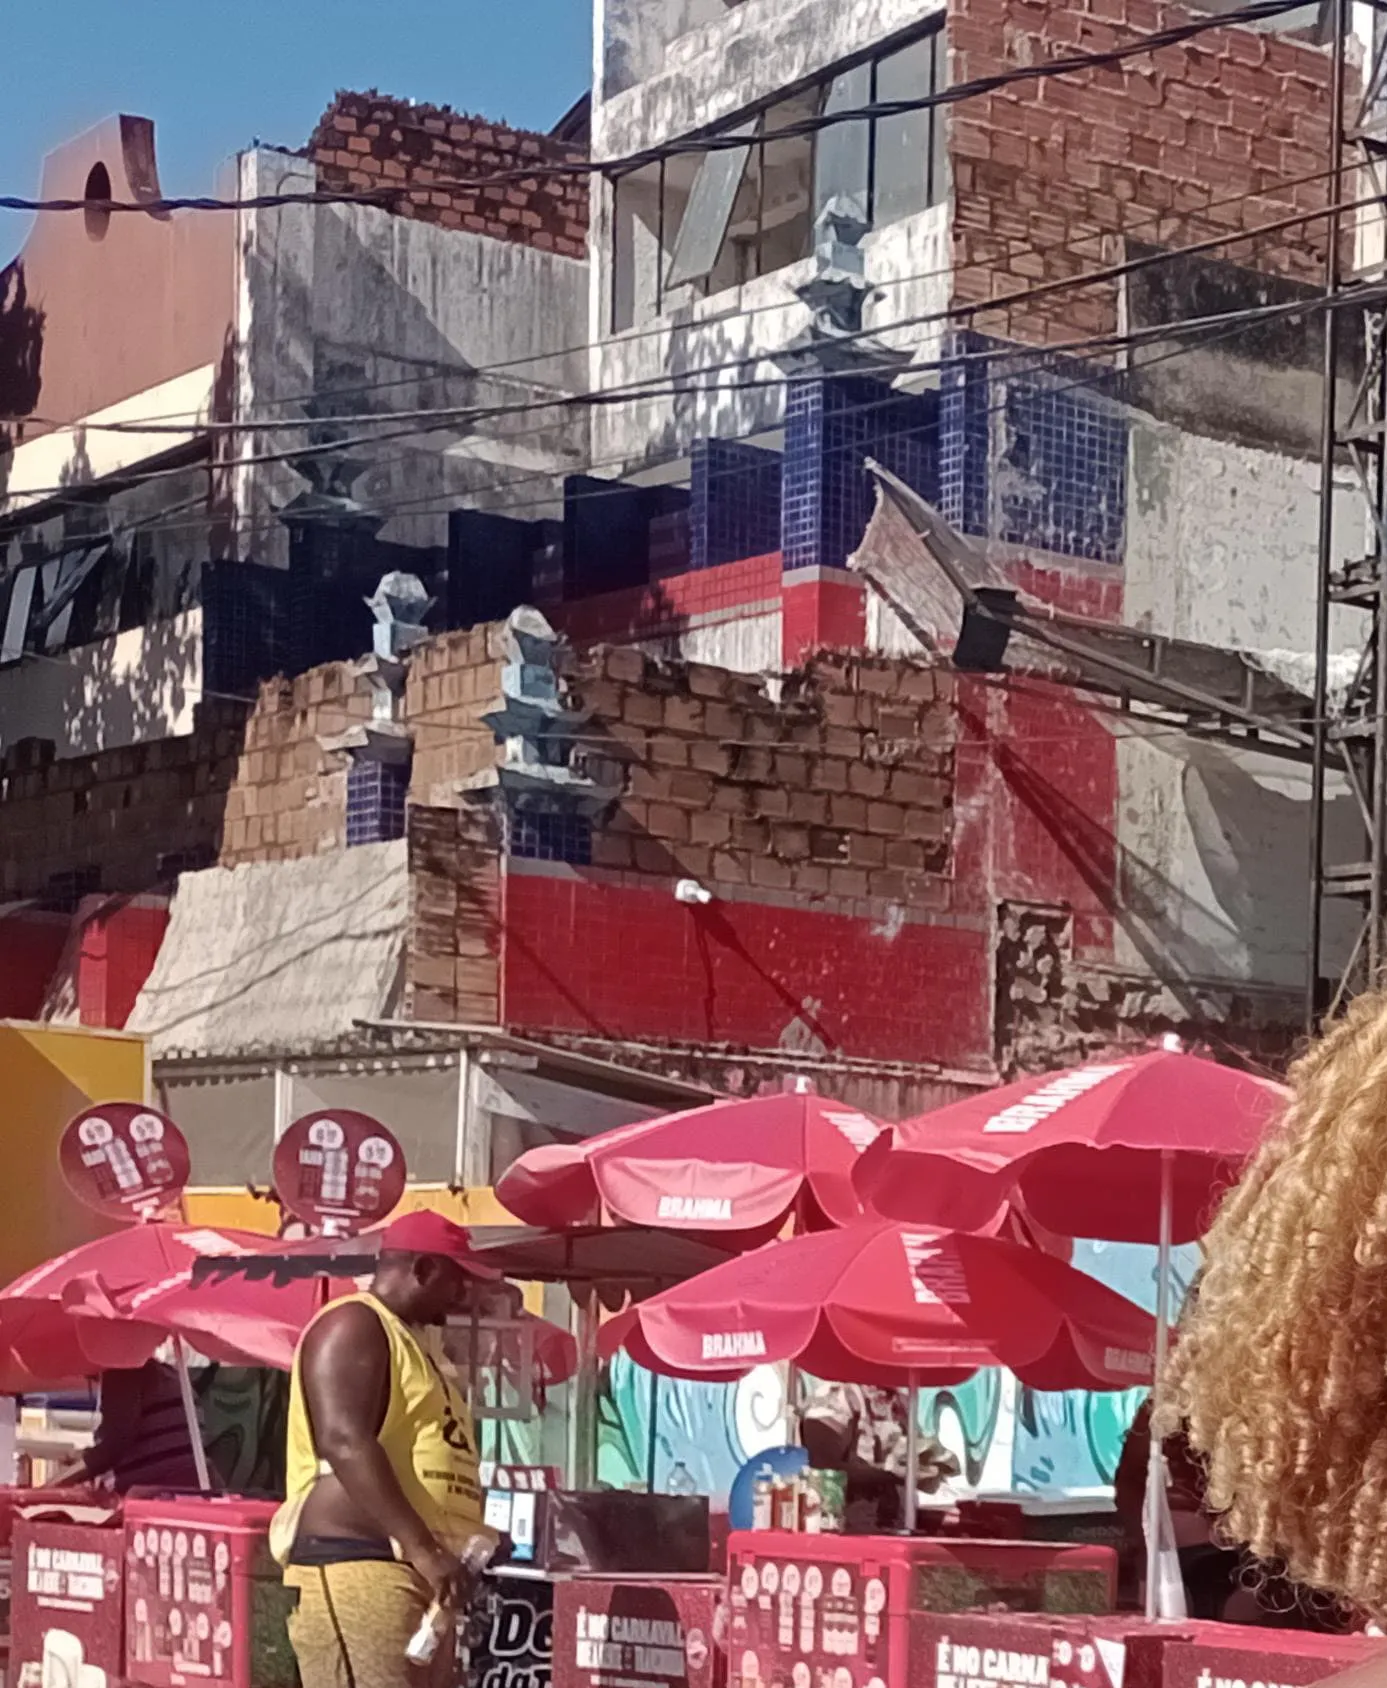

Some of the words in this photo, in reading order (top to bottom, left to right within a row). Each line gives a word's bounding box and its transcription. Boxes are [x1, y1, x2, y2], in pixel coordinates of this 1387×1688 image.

[657, 1195, 733, 1221] BRAHMA
[702, 1329, 767, 1359] BRAHMA
[953, 1645, 980, 1676] NO
[983, 1648, 1049, 1685] CARNA
